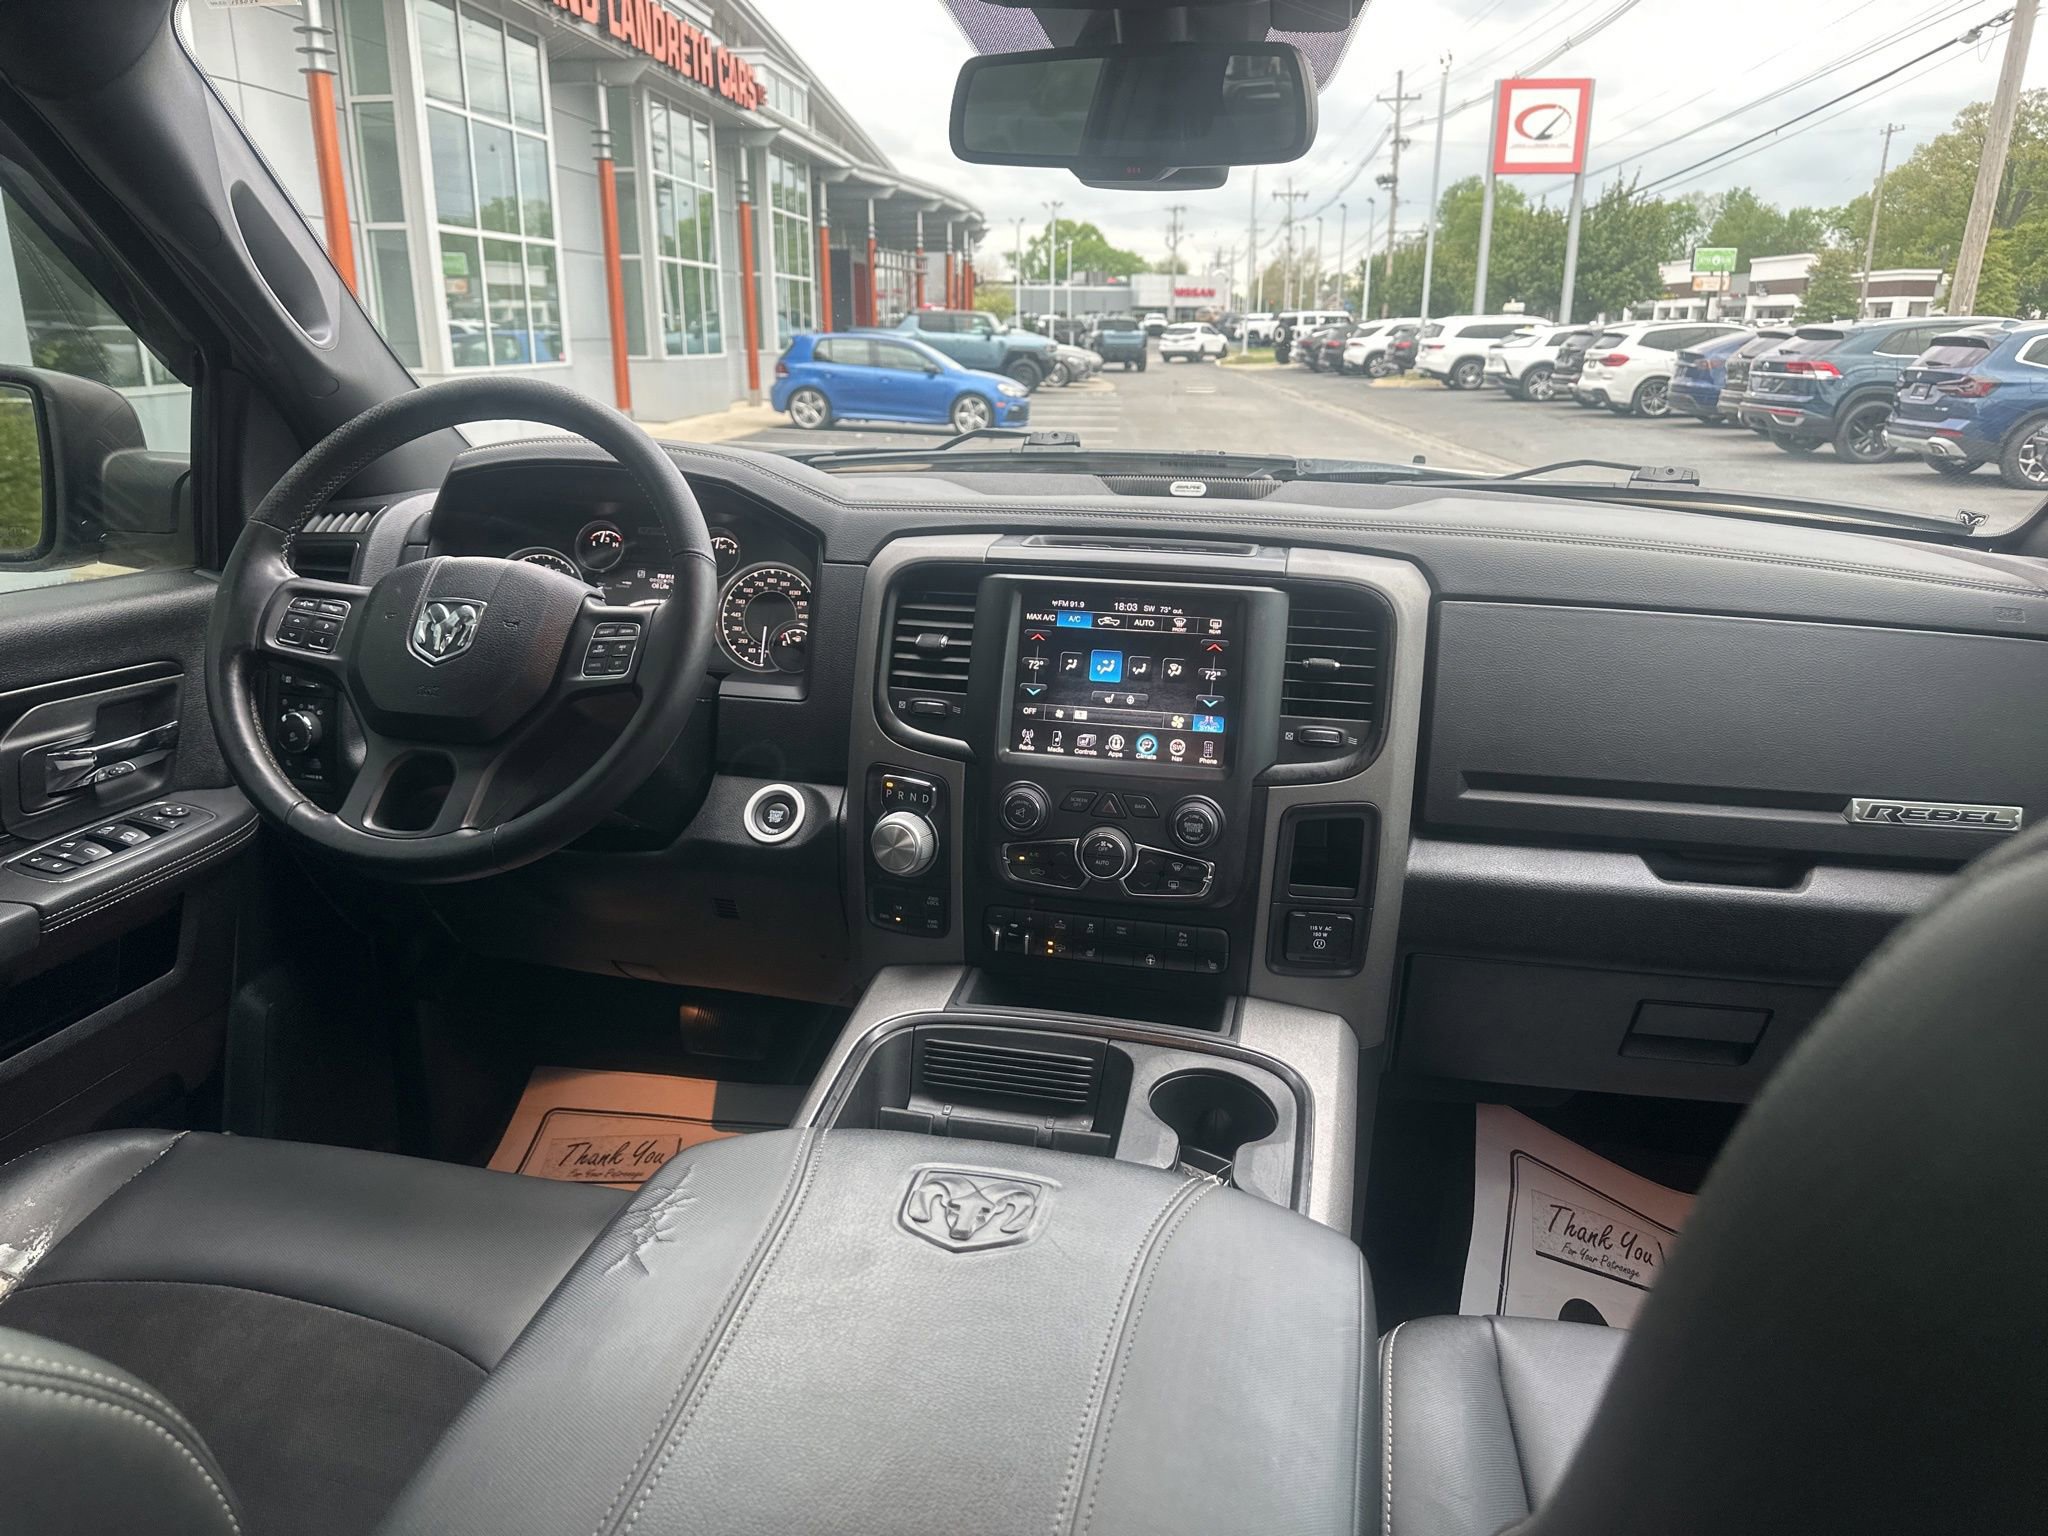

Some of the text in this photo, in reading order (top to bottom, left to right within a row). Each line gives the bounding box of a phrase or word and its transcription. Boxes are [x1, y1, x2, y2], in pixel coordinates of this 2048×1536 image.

[608, 0, 714, 89] LANDRETH
[717, 46, 757, 112] CARS
[1114, 602, 1138, 611] 18:03
[1043, 613, 1056, 621] A/C
[1068, 615, 1081, 623] A/C
[1133, 619, 1155, 627] AUTO
[1028, 660, 1044, 670] 72°
[1204, 670, 1222, 680] 72°
[1023, 707, 1037, 715] OFF
[1018, 743, 1035, 751] Radio
[1074, 748, 1098, 756] Controls
[1107, 750, 1123, 758] Apps
[1135, 752, 1157, 760] Climate
[1199, 757, 1218, 765] Phone
[886, 789, 929, 803] P R N D
[1862, 803, 2011, 825] REBEL
[558, 1140, 665, 1167] Thank You
[1548, 1204, 1654, 1267] Thank You
[1561, 1241, 1640, 1280] For Your Patronage
